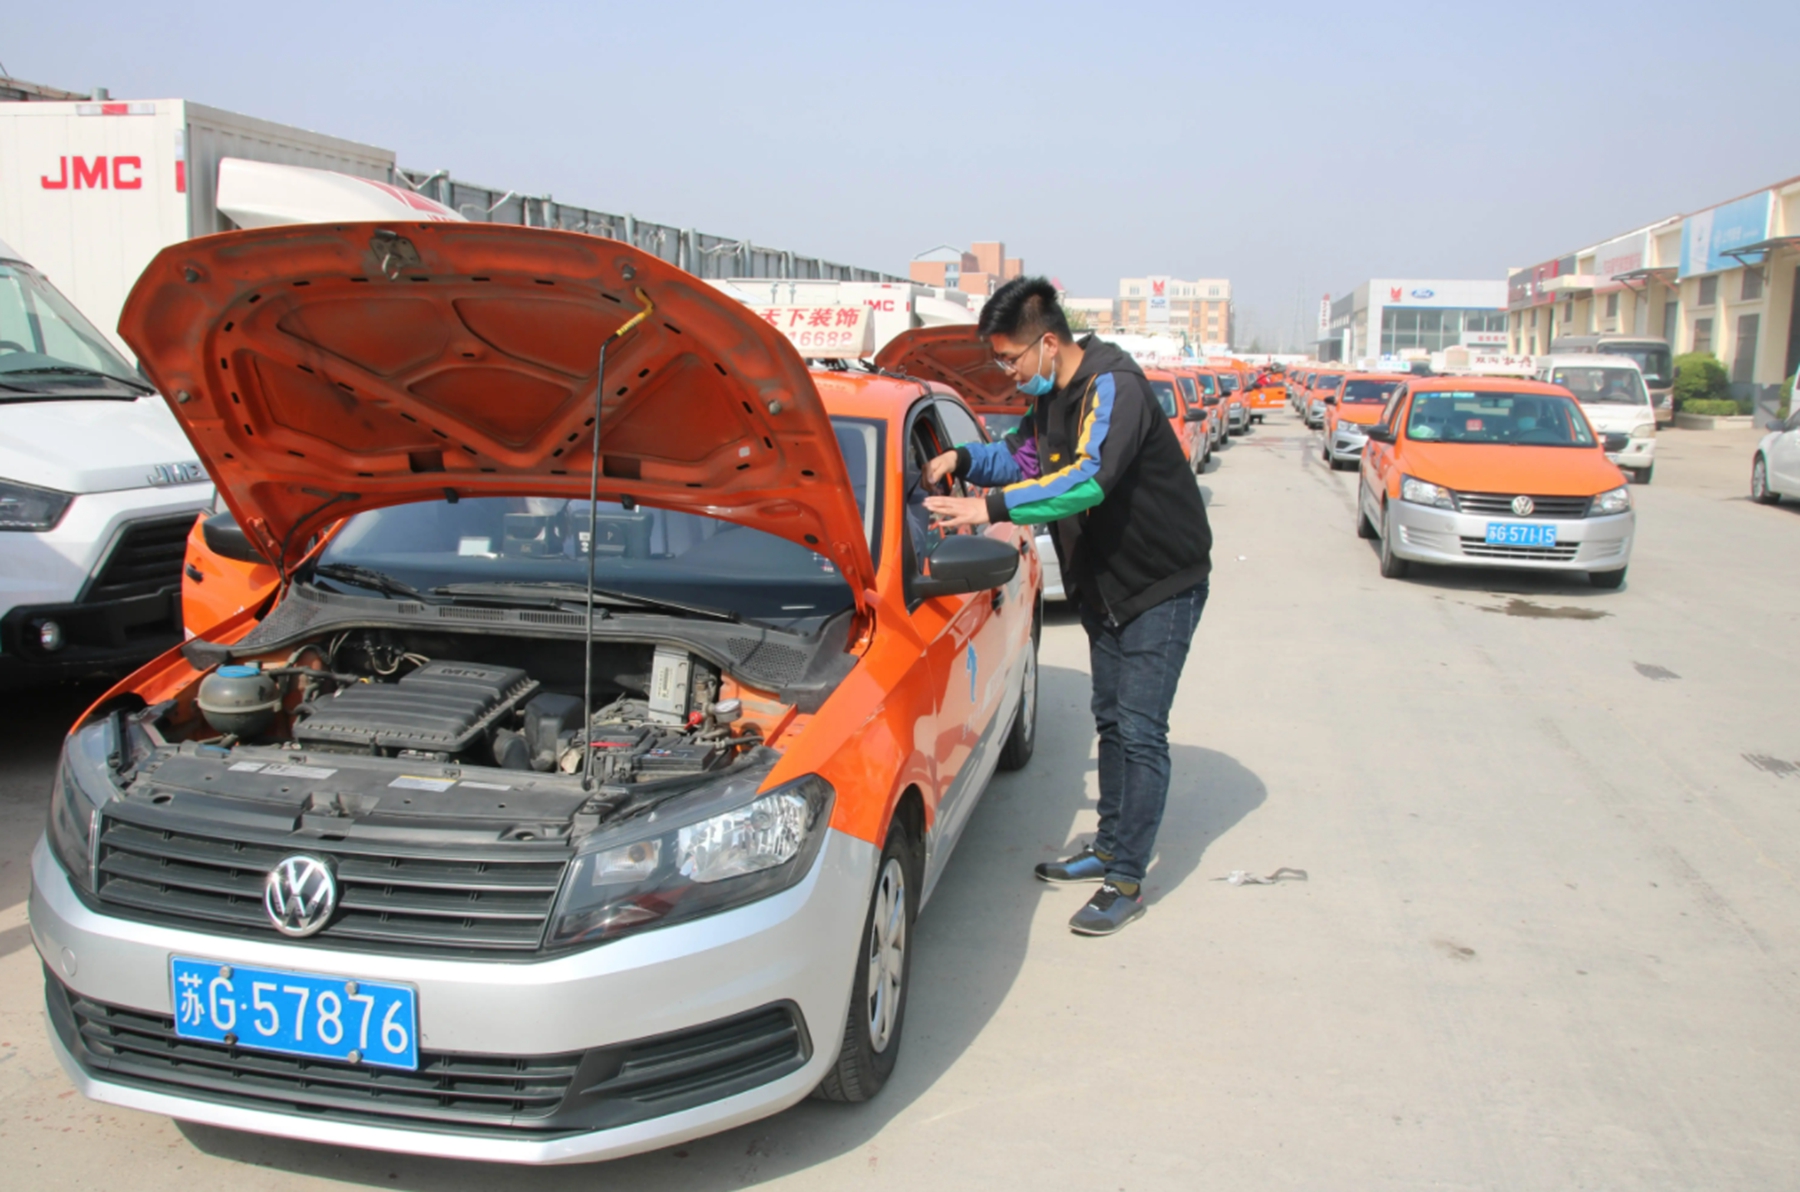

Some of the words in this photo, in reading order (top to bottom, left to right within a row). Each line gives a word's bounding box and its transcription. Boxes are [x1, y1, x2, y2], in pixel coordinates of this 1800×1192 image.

[41, 155, 142, 190] JMC
[863, 299, 895, 312] MC
[760, 307, 861, 328] 天下装饰
[441, 667, 486, 678] MPI
